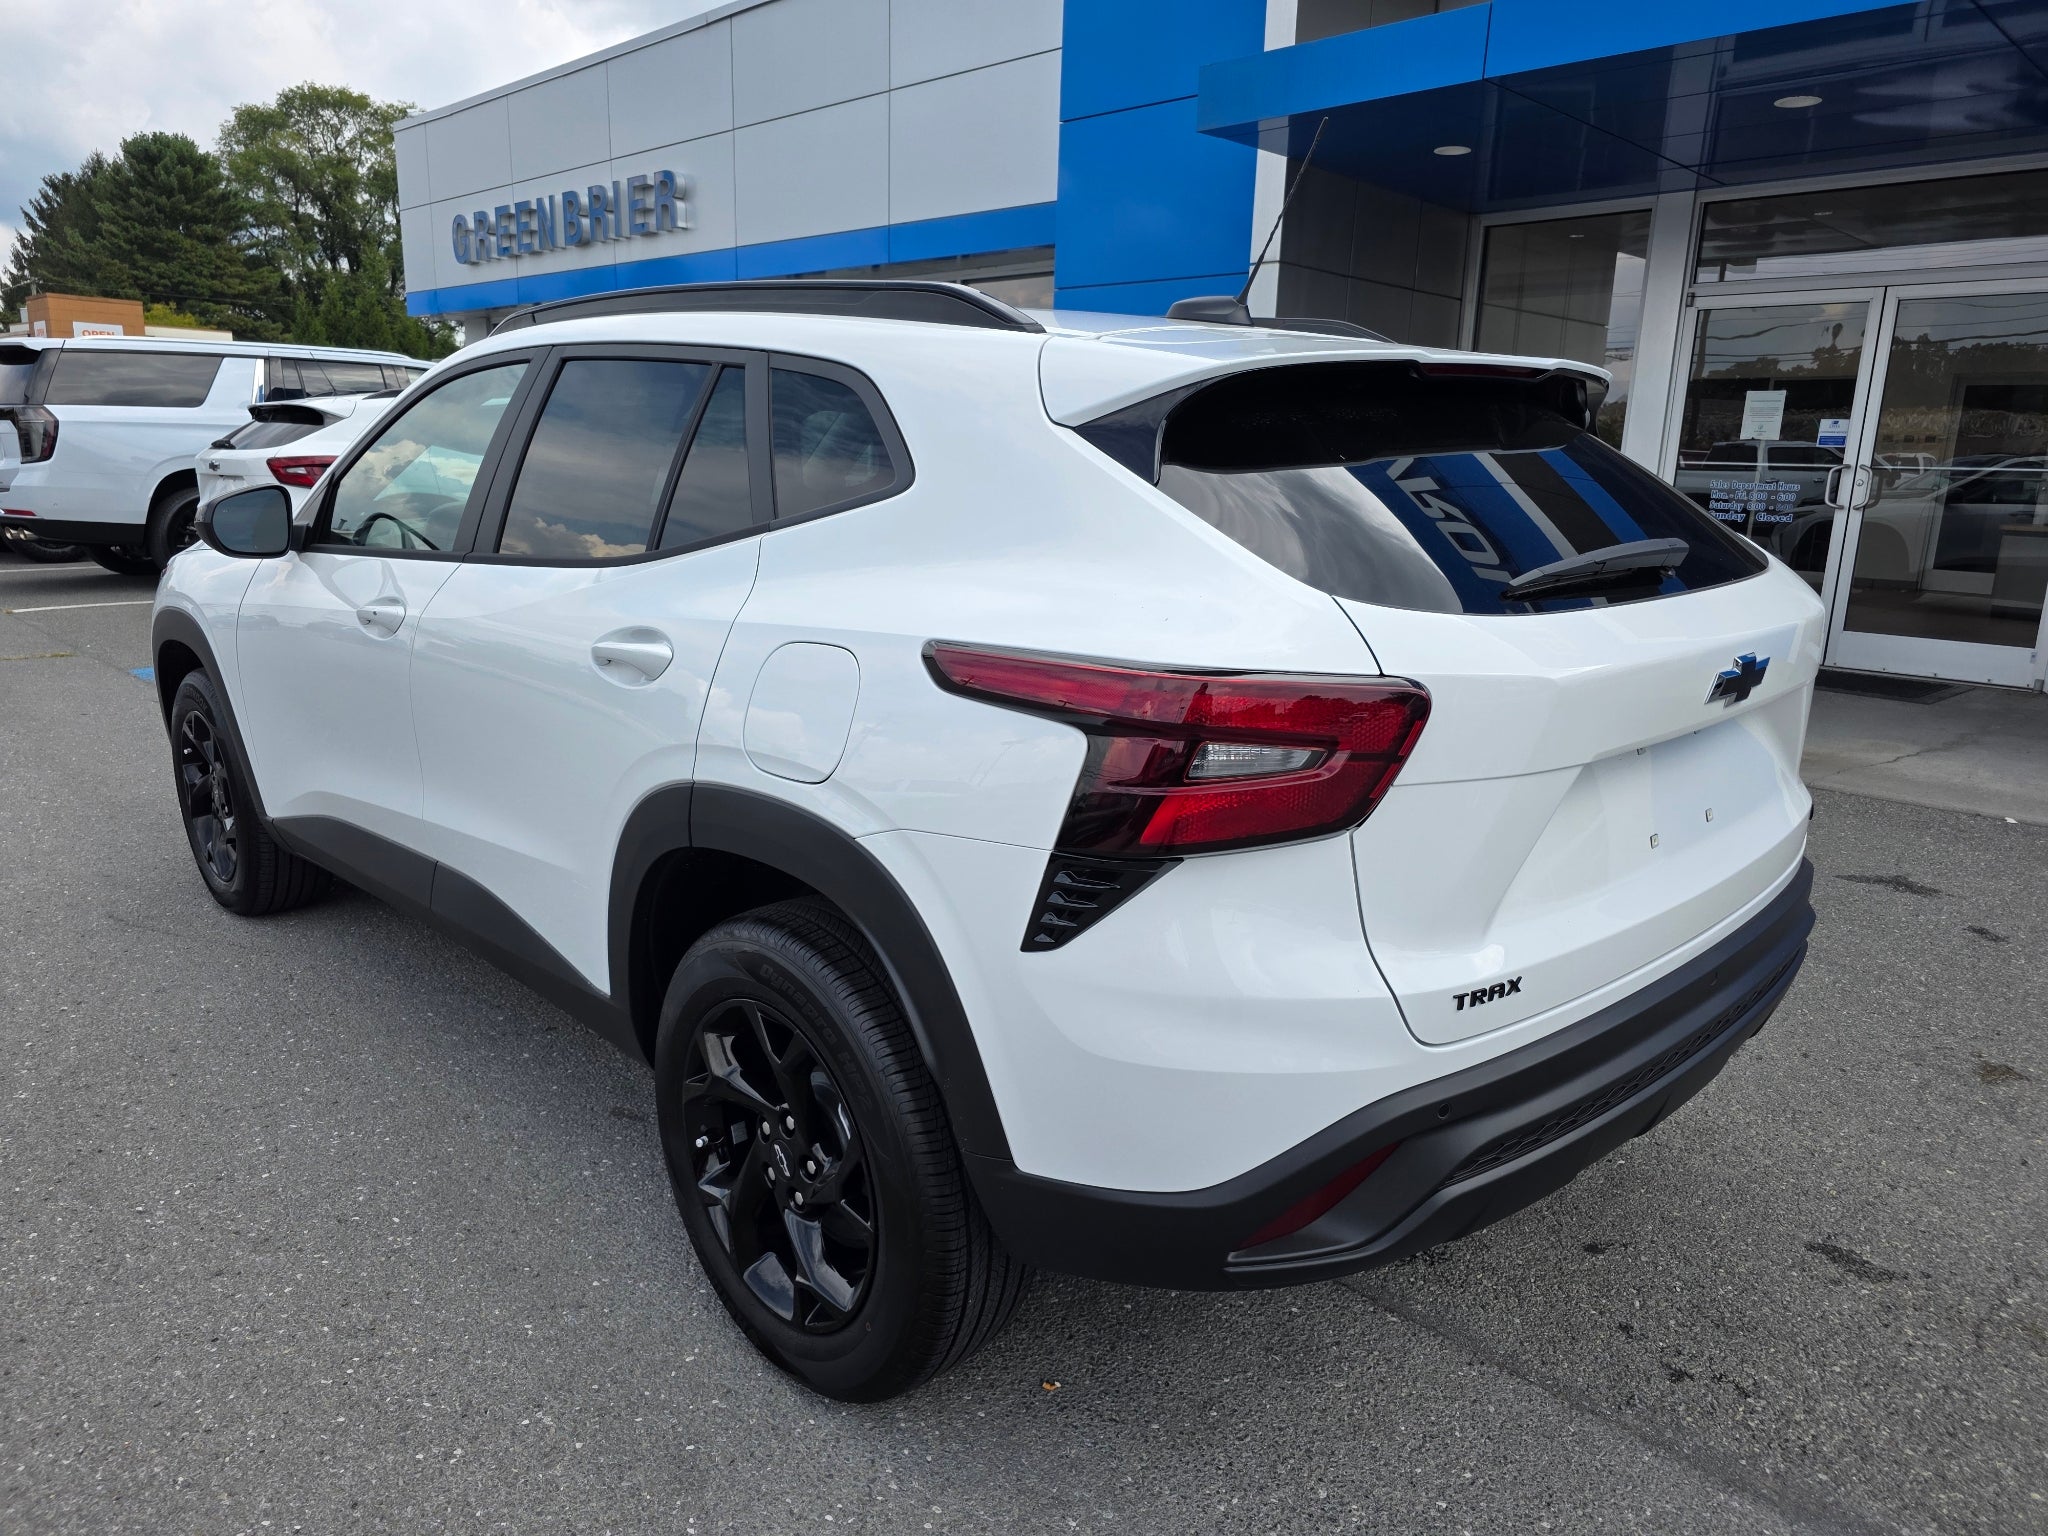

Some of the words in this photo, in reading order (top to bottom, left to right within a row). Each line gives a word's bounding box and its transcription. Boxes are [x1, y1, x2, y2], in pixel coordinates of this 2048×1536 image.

[452, 169, 687, 265] GREENBRIER
[1710, 480, 1729, 489] Sales
[1732, 480, 1777, 491] Department
[1778, 481, 1800, 492] Hours
[1750, 491, 1767, 501] 8:00
[1776, 493, 1797, 502] 6:00
[1709, 500, 1744, 512] Saturday
[1747, 502, 1766, 511] 8:00
[1756, 512, 1793, 523] Closed
[1453, 975, 1522, 1010] TRAX
